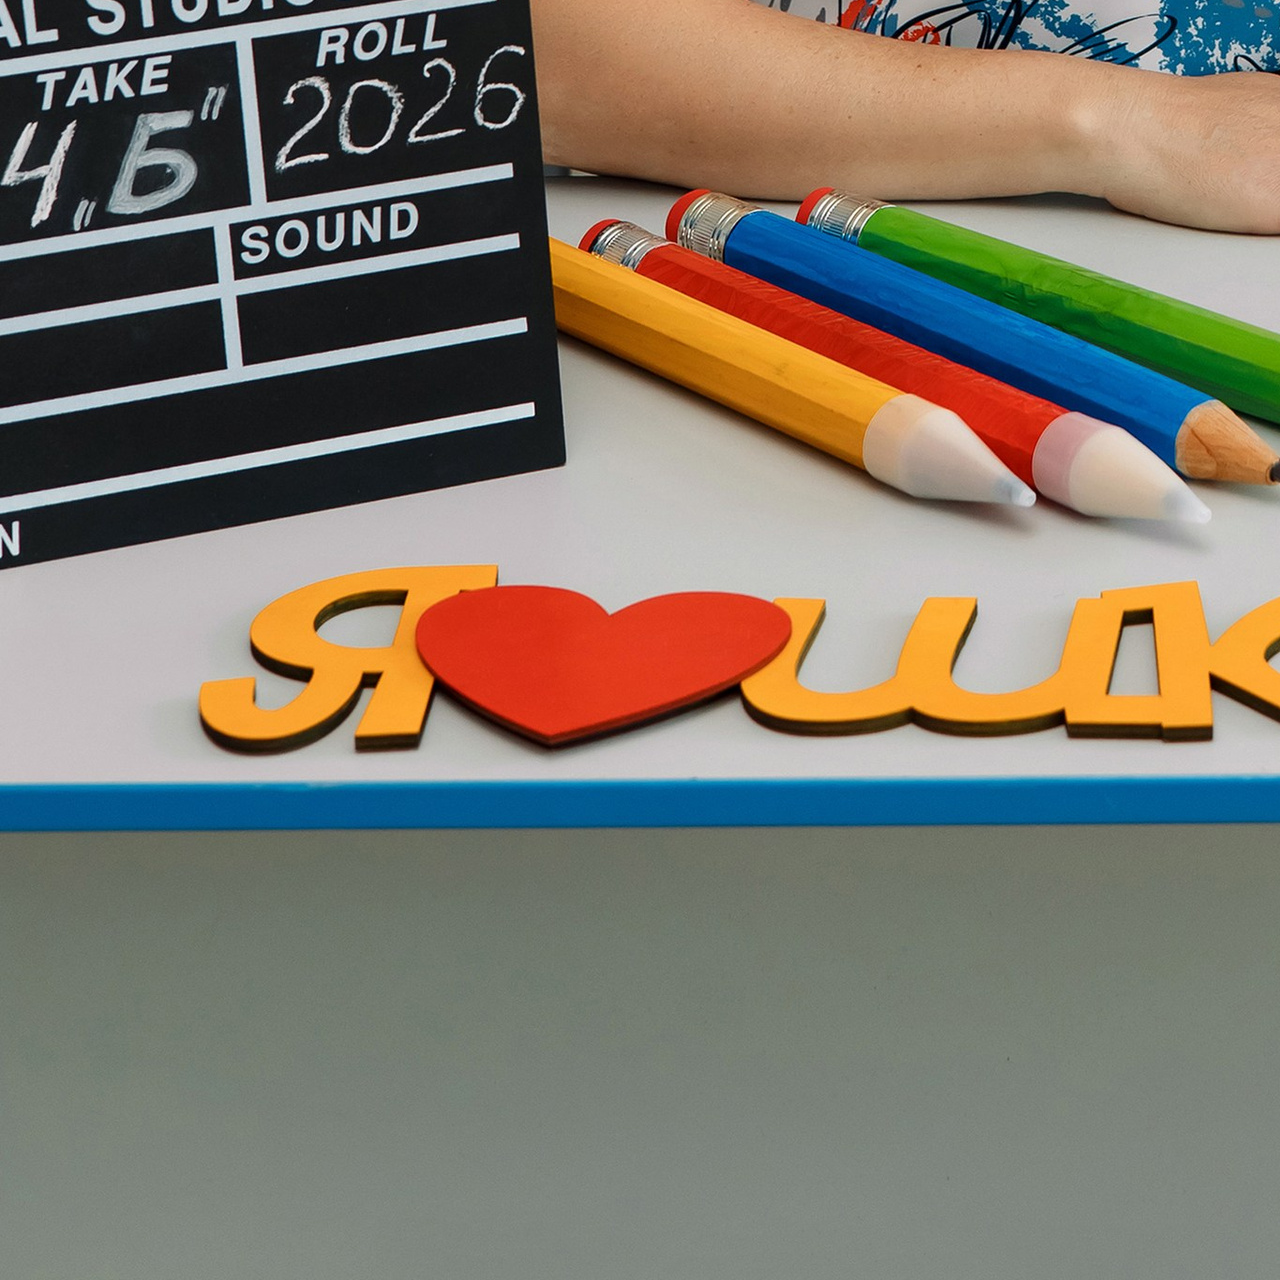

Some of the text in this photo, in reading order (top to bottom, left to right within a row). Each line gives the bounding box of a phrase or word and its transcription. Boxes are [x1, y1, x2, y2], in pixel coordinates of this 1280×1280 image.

[316, 13, 447, 67] ROLL
[36, 54, 172, 111] TAKE
[275, 45, 526, 173] 2026
[240, 201, 419, 264] SOUND
[199, 563, 499, 756] Я
